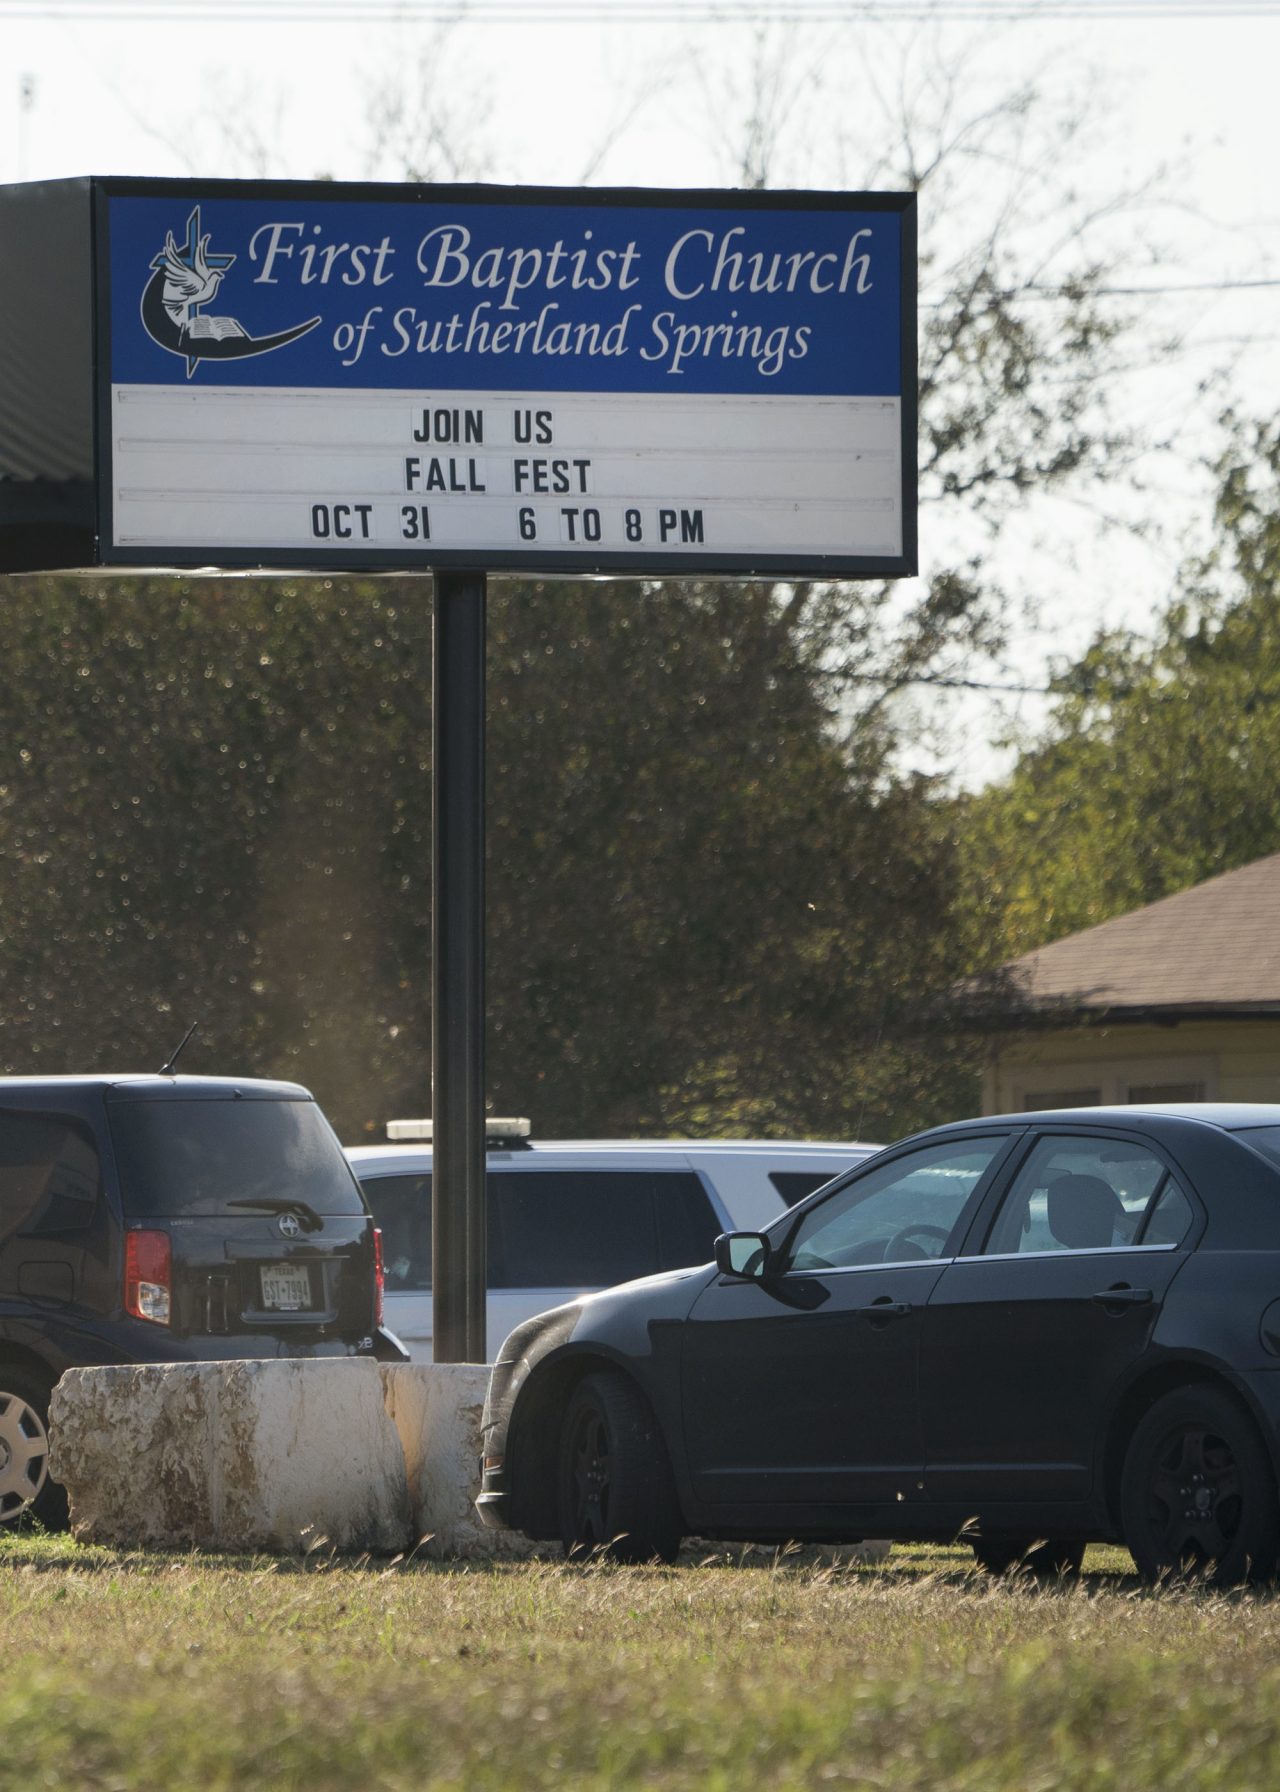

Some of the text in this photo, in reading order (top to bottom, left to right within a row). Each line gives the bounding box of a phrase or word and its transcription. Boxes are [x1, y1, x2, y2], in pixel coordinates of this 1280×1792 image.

[248, 222, 874, 310] First Baptist Church
[332, 301, 812, 376] of Sutherland Springs
[413, 409, 554, 444] JOIN US
[405, 457, 591, 494] FALL FEST
[311, 504, 705, 544] OCT 31 6 TO 8 PM
